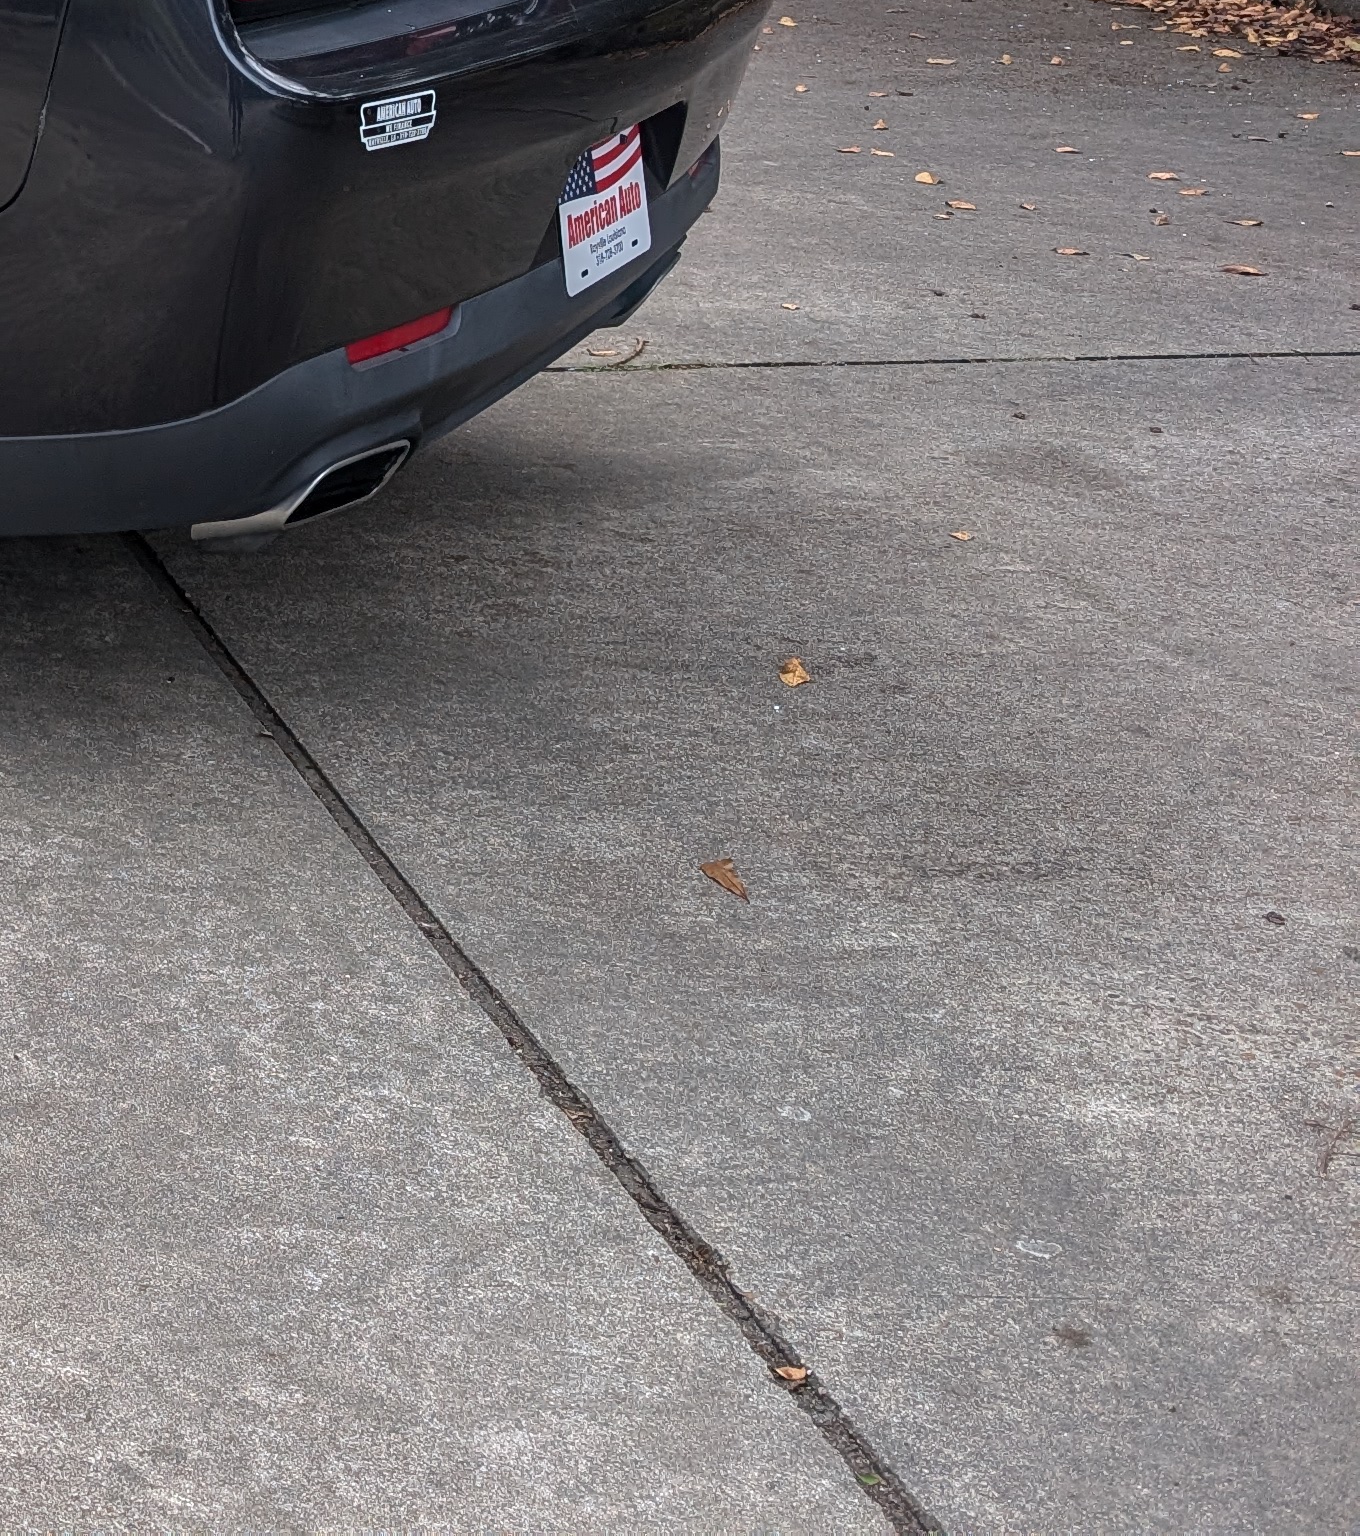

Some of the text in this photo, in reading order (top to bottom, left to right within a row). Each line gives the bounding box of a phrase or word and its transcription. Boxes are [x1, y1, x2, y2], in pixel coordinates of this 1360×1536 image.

[376, 97, 422, 122] AMERICAN AUTO
[567, 181, 642, 249] American Auto
